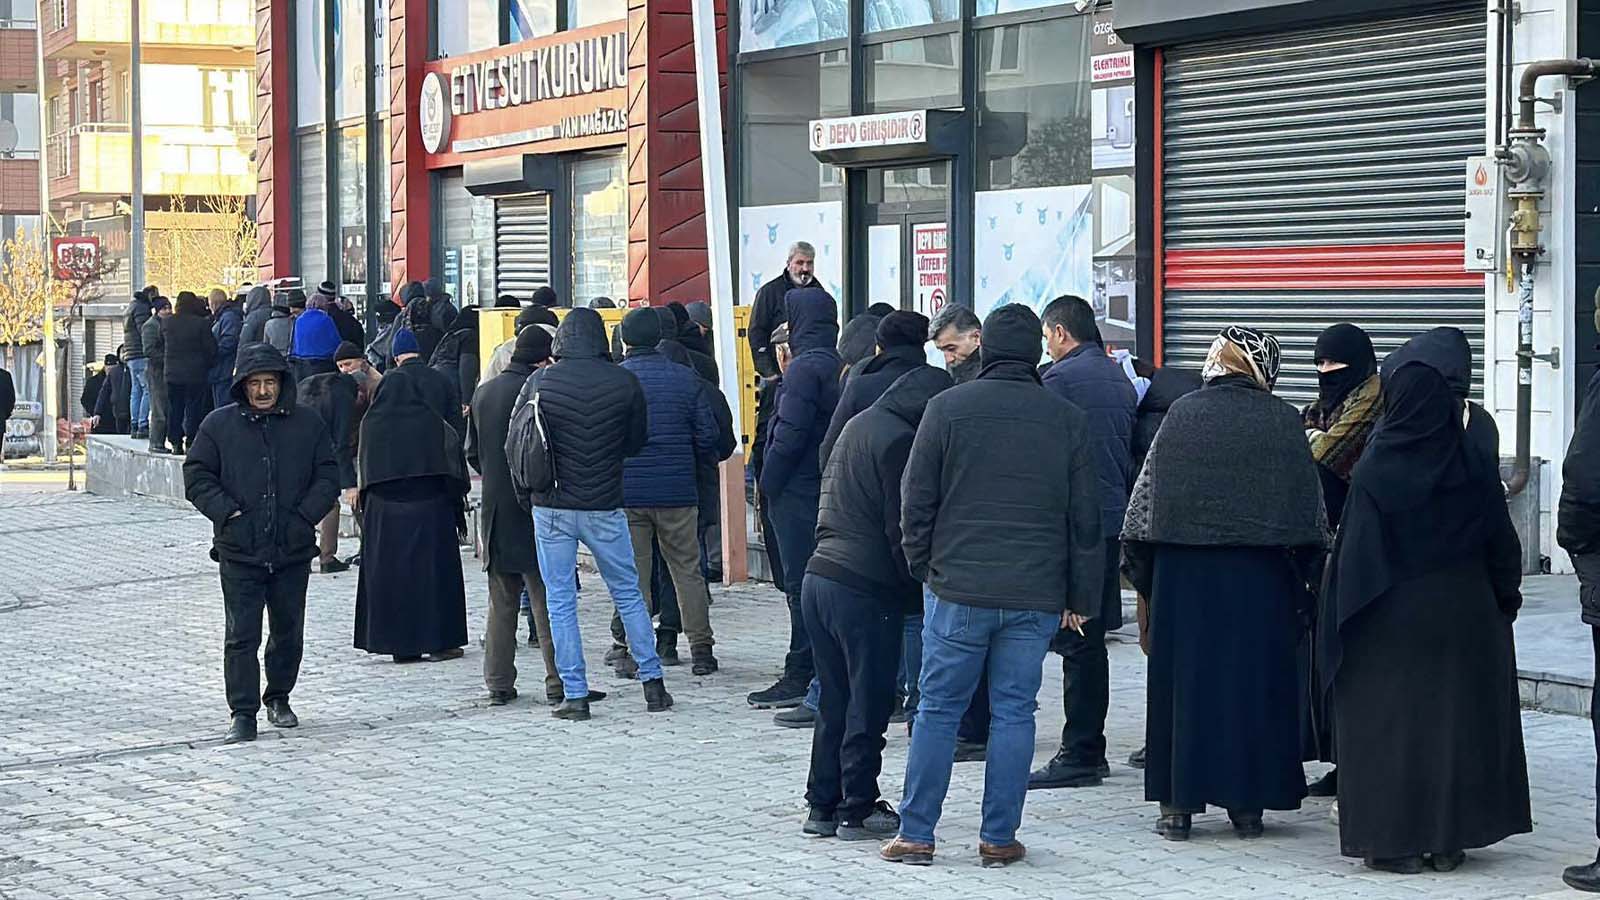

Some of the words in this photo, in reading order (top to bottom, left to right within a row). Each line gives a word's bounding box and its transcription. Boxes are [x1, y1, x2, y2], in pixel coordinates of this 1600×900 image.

[451, 63, 473, 116] ET
[472, 60, 496, 112] VE
[499, 50, 537, 109] SÜT
[537, 31, 628, 101] KURUMU
[560, 116, 578, 139] VAN
[829, 122, 857, 145] DEPO
[917, 255, 940, 271] LÜTFEN
